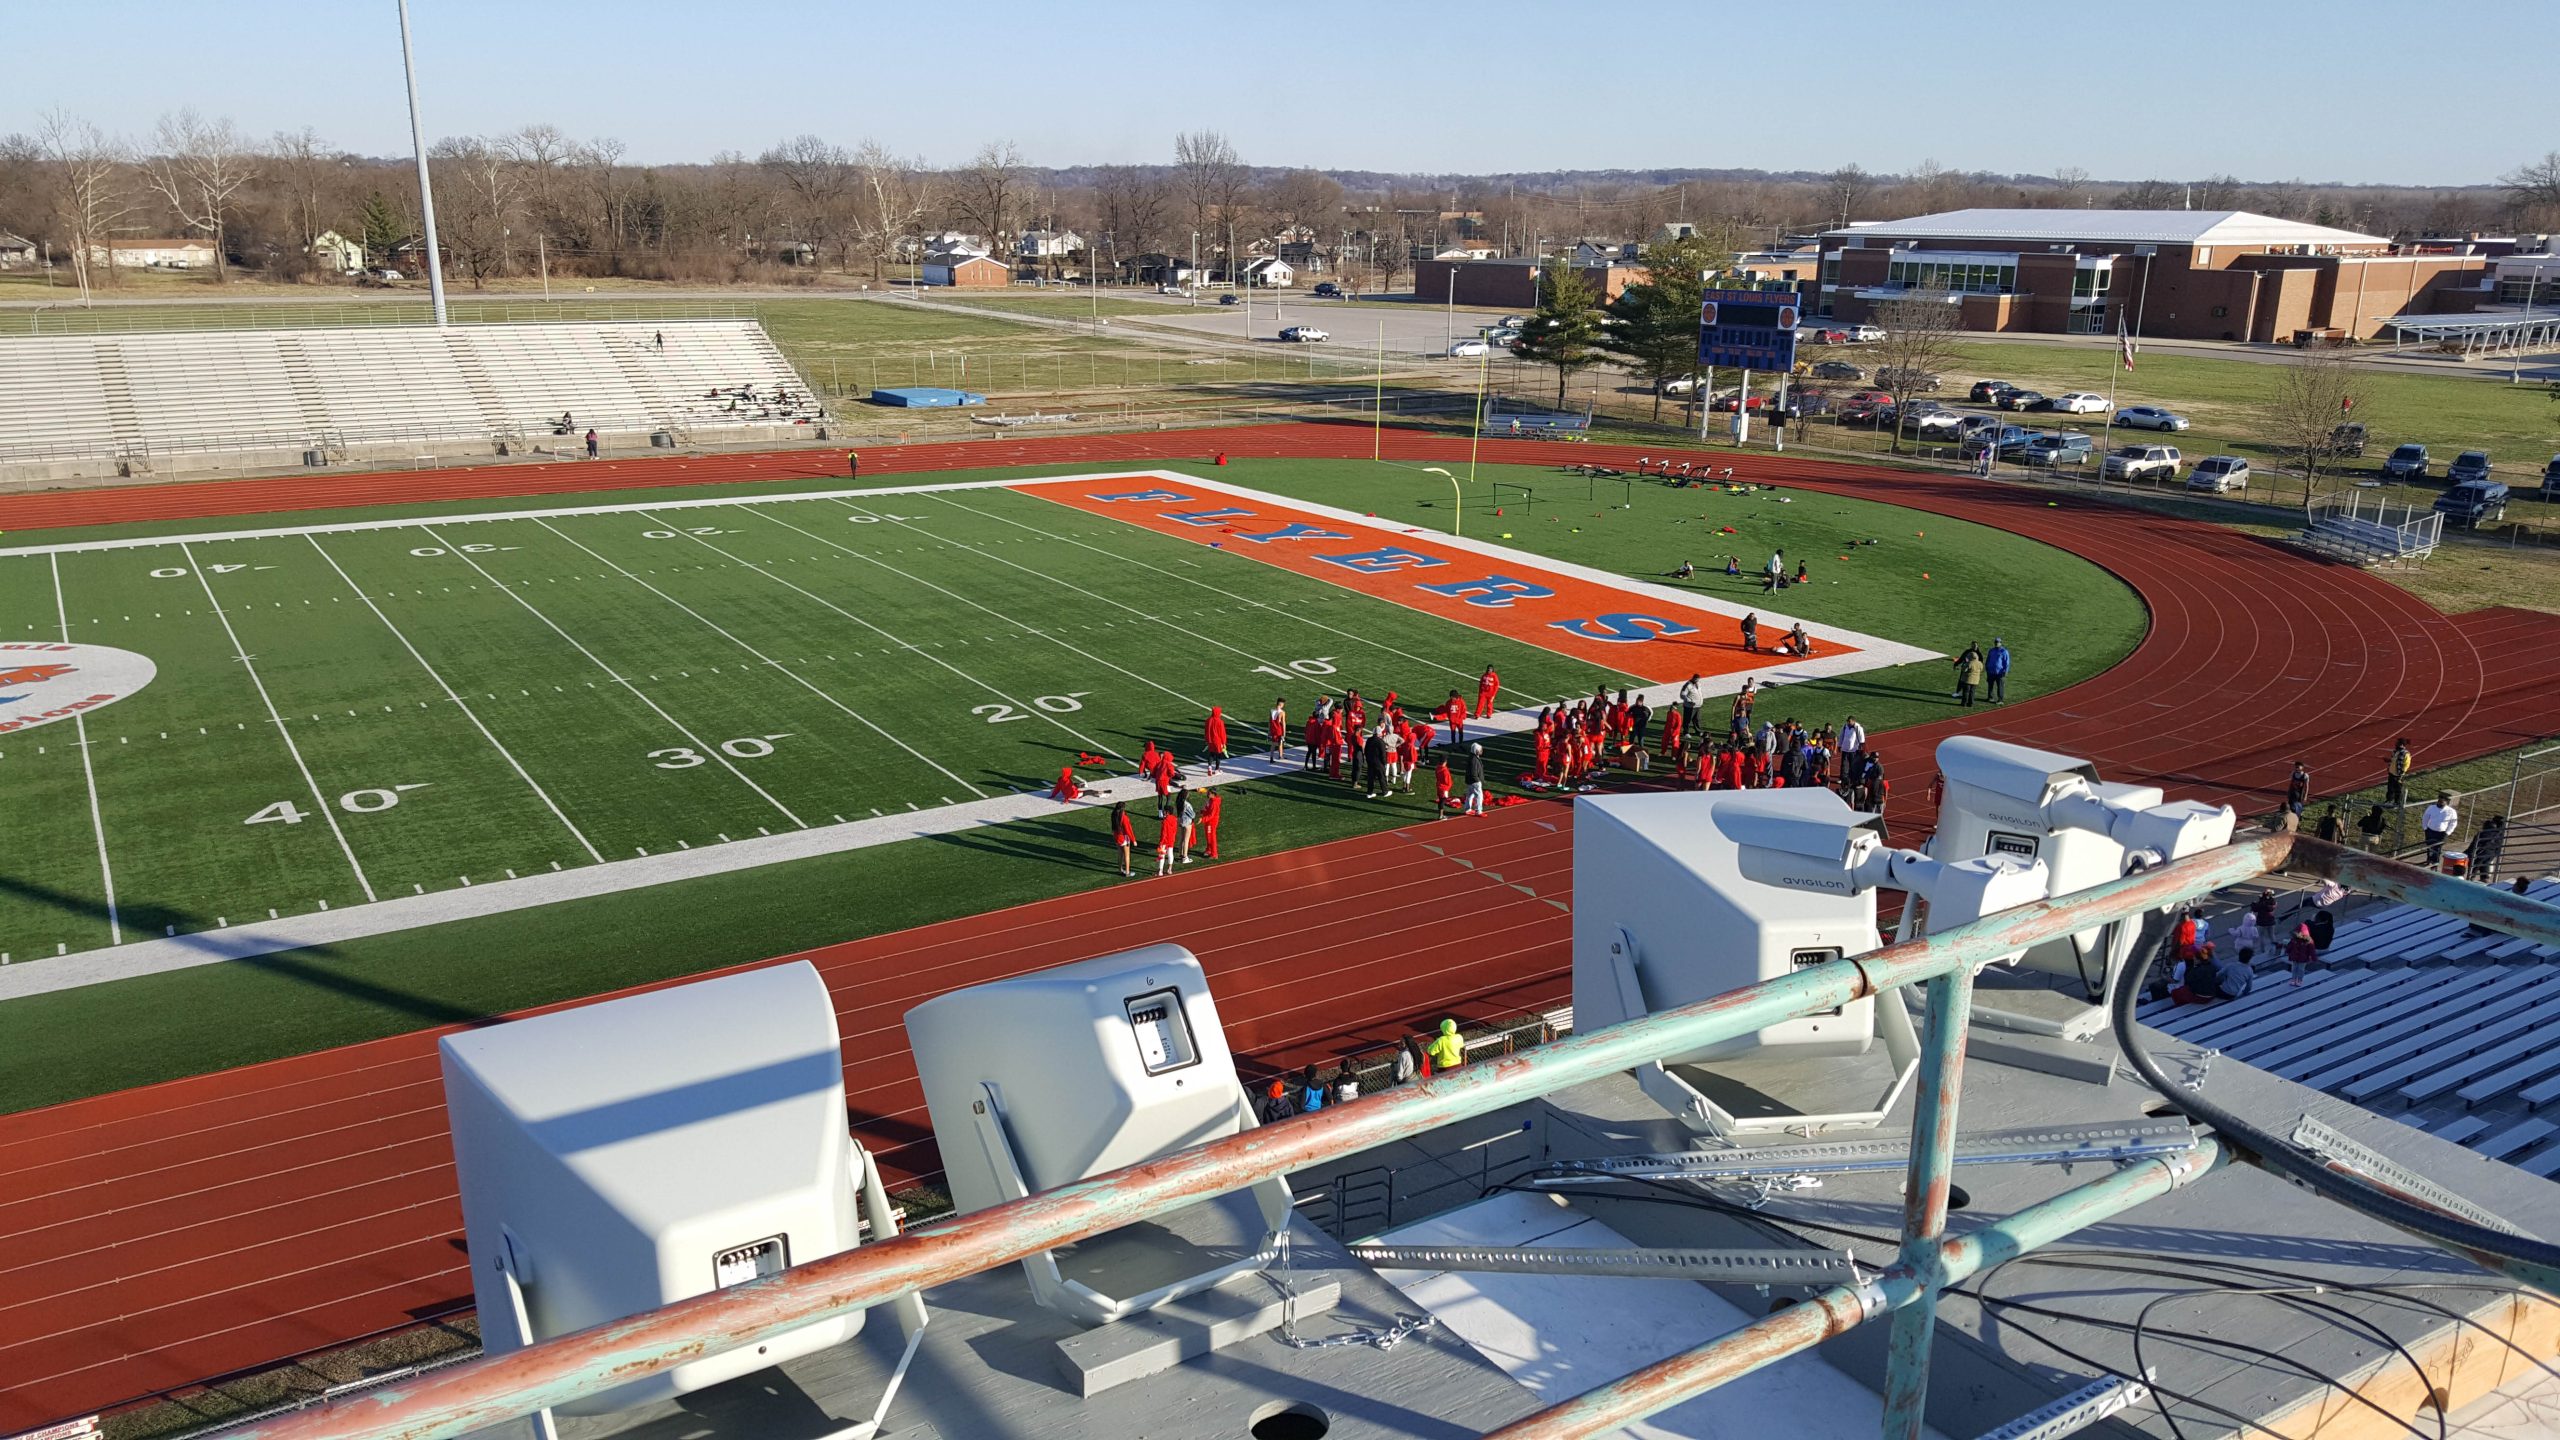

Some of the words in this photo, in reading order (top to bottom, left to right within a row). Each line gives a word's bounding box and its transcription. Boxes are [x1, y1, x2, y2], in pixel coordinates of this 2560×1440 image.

[1705, 291, 1724, 300] EAST
[1727, 292, 1737, 301] ST
[1739, 292, 1762, 303] LOUIS
[1765, 294, 1795, 304] FLYERS
[1085, 488, 1700, 645] FLYERS
[1250, 660, 1337, 681] 10
[971, 695, 1084, 724] 20
[647, 737, 775, 769] 30
[243, 789, 400, 825] 40
[1146, 976, 1154, 986] 6
